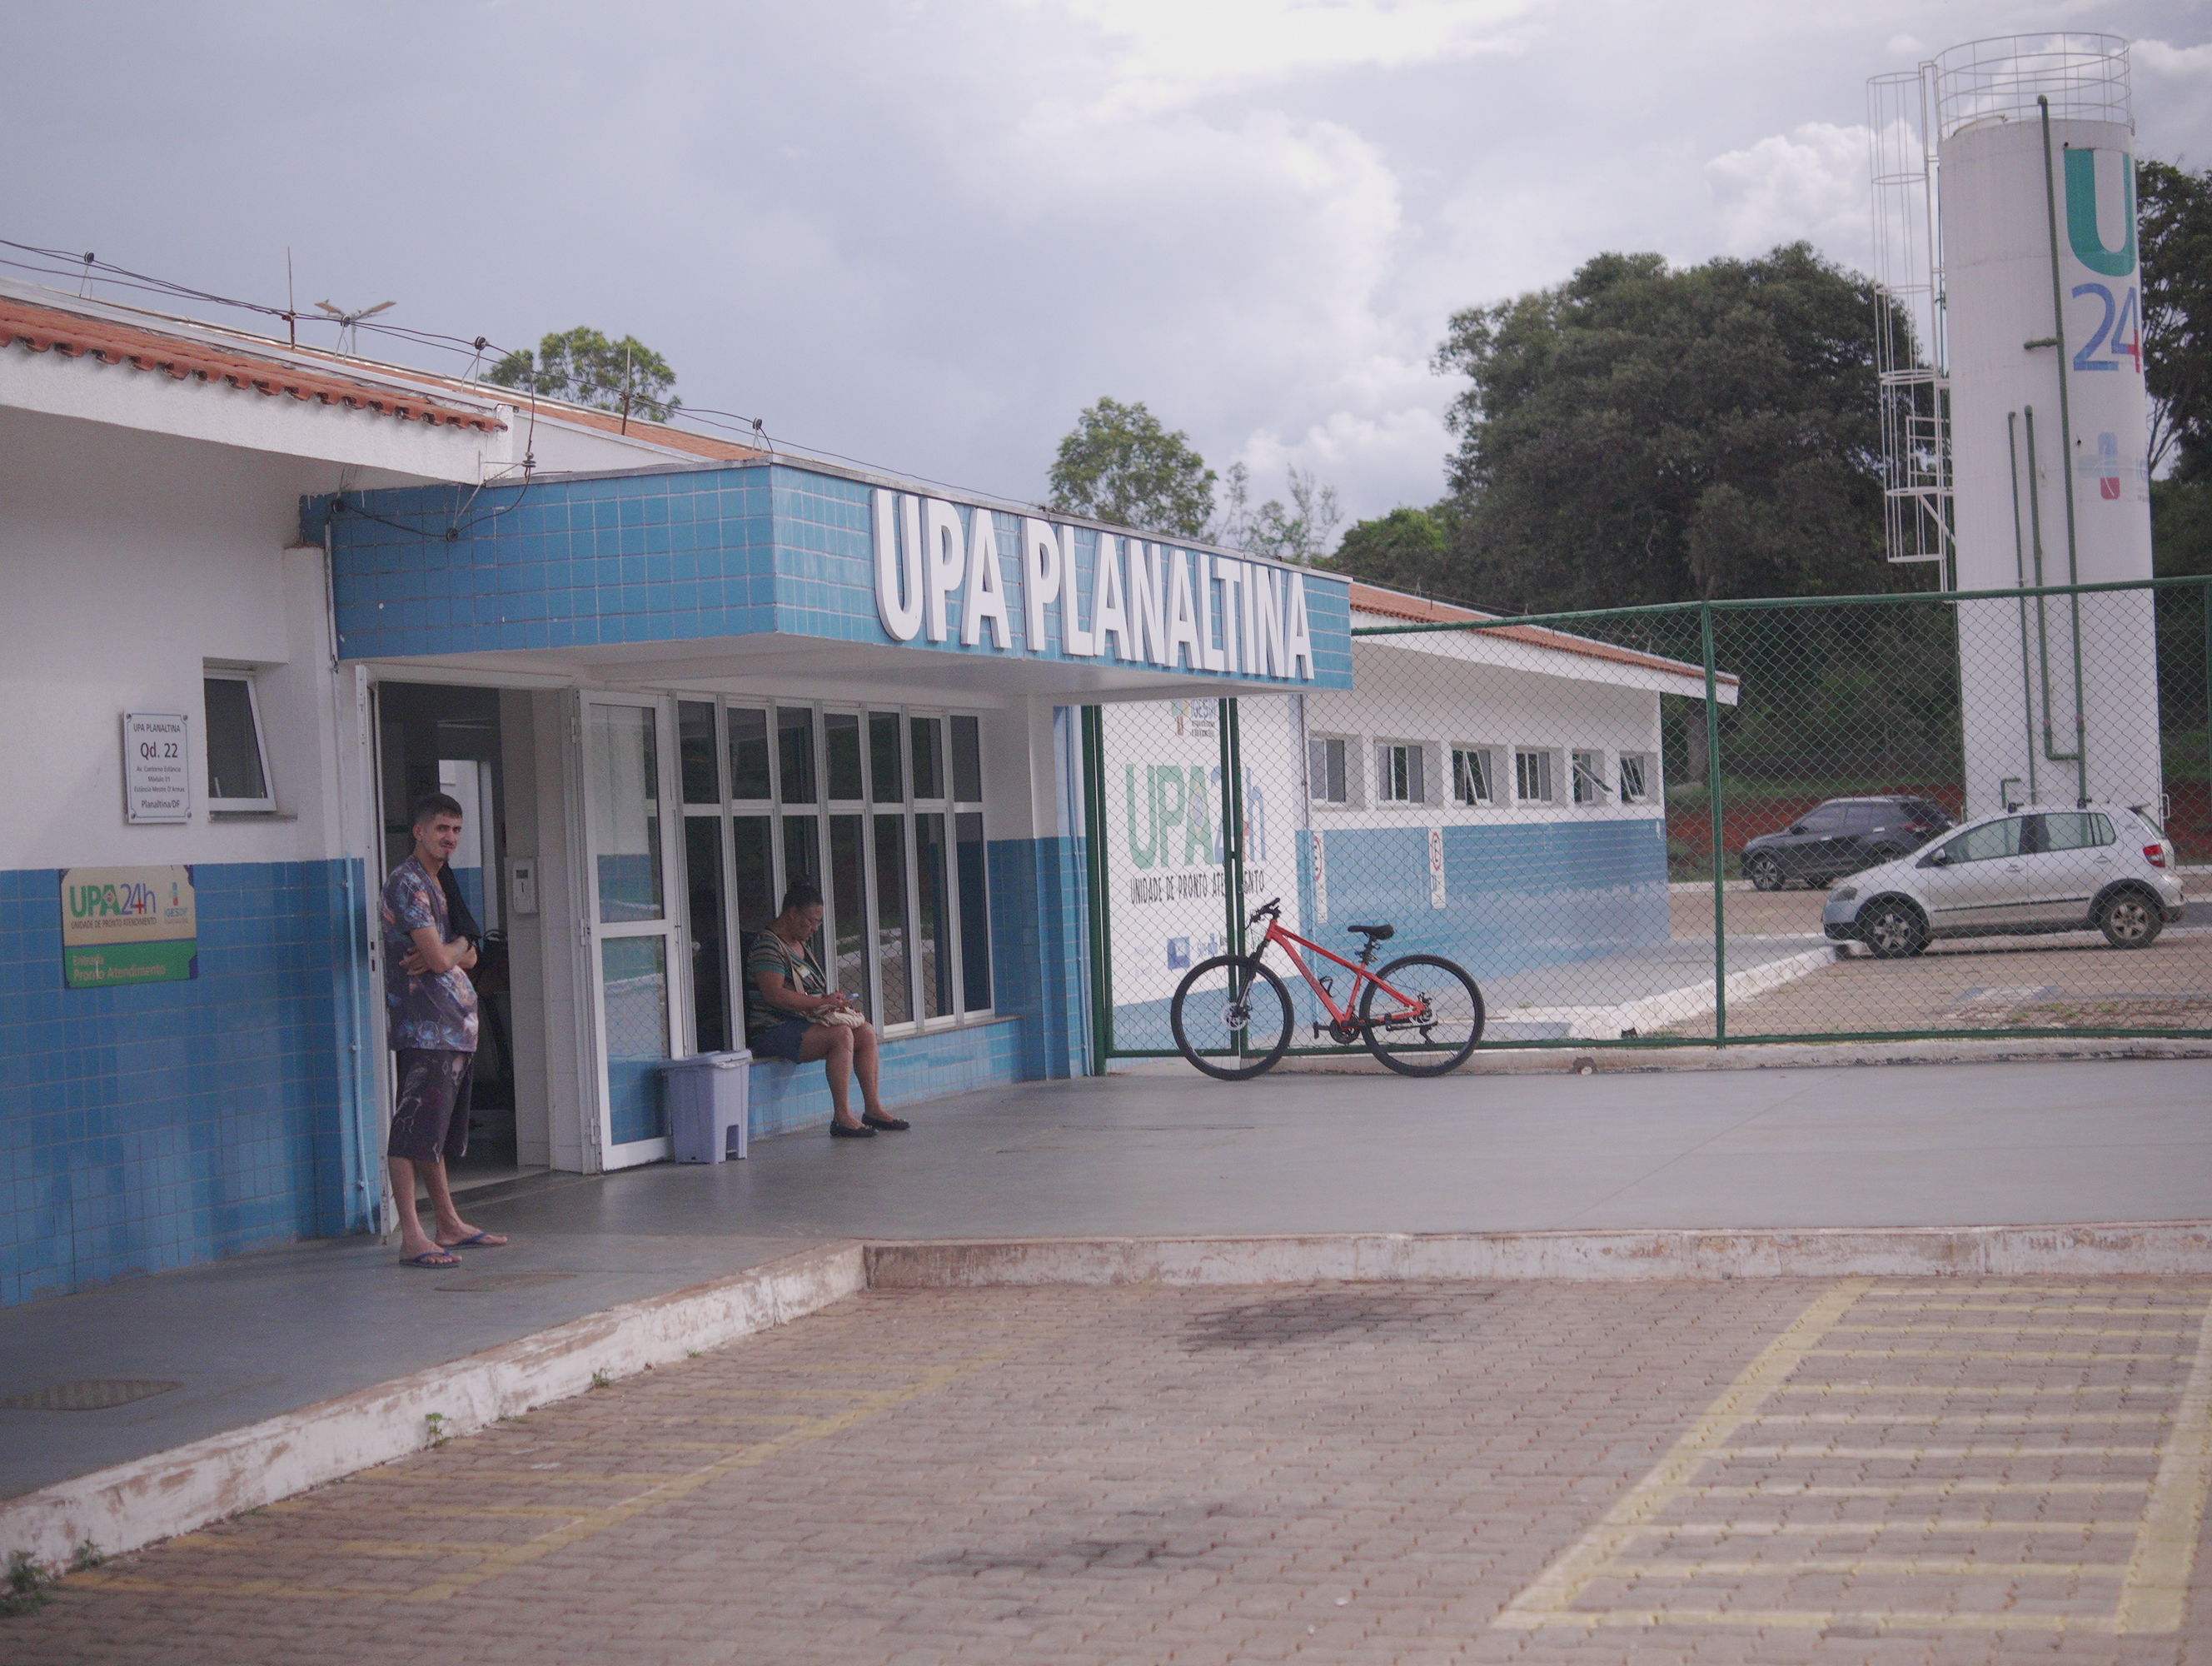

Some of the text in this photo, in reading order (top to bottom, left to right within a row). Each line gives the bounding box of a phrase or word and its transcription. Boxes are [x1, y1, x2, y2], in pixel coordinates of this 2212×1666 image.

[871, 488, 1315, 680] UPA PLANALTINA
[133, 724, 181, 733] UPA PLANALTINA
[140, 741, 178, 761] Qd. 22
[1130, 877, 1163, 905] UNIDADE
[1166, 875, 1175, 900] DE
[1178, 872, 1208, 900] PRONTO
[71, 920, 93, 930] UNIDADE
[94, 920, 101, 929] DE
[102, 919, 122, 928] PRONTO
[122, 917, 157, 927] ATENDIMENTO
